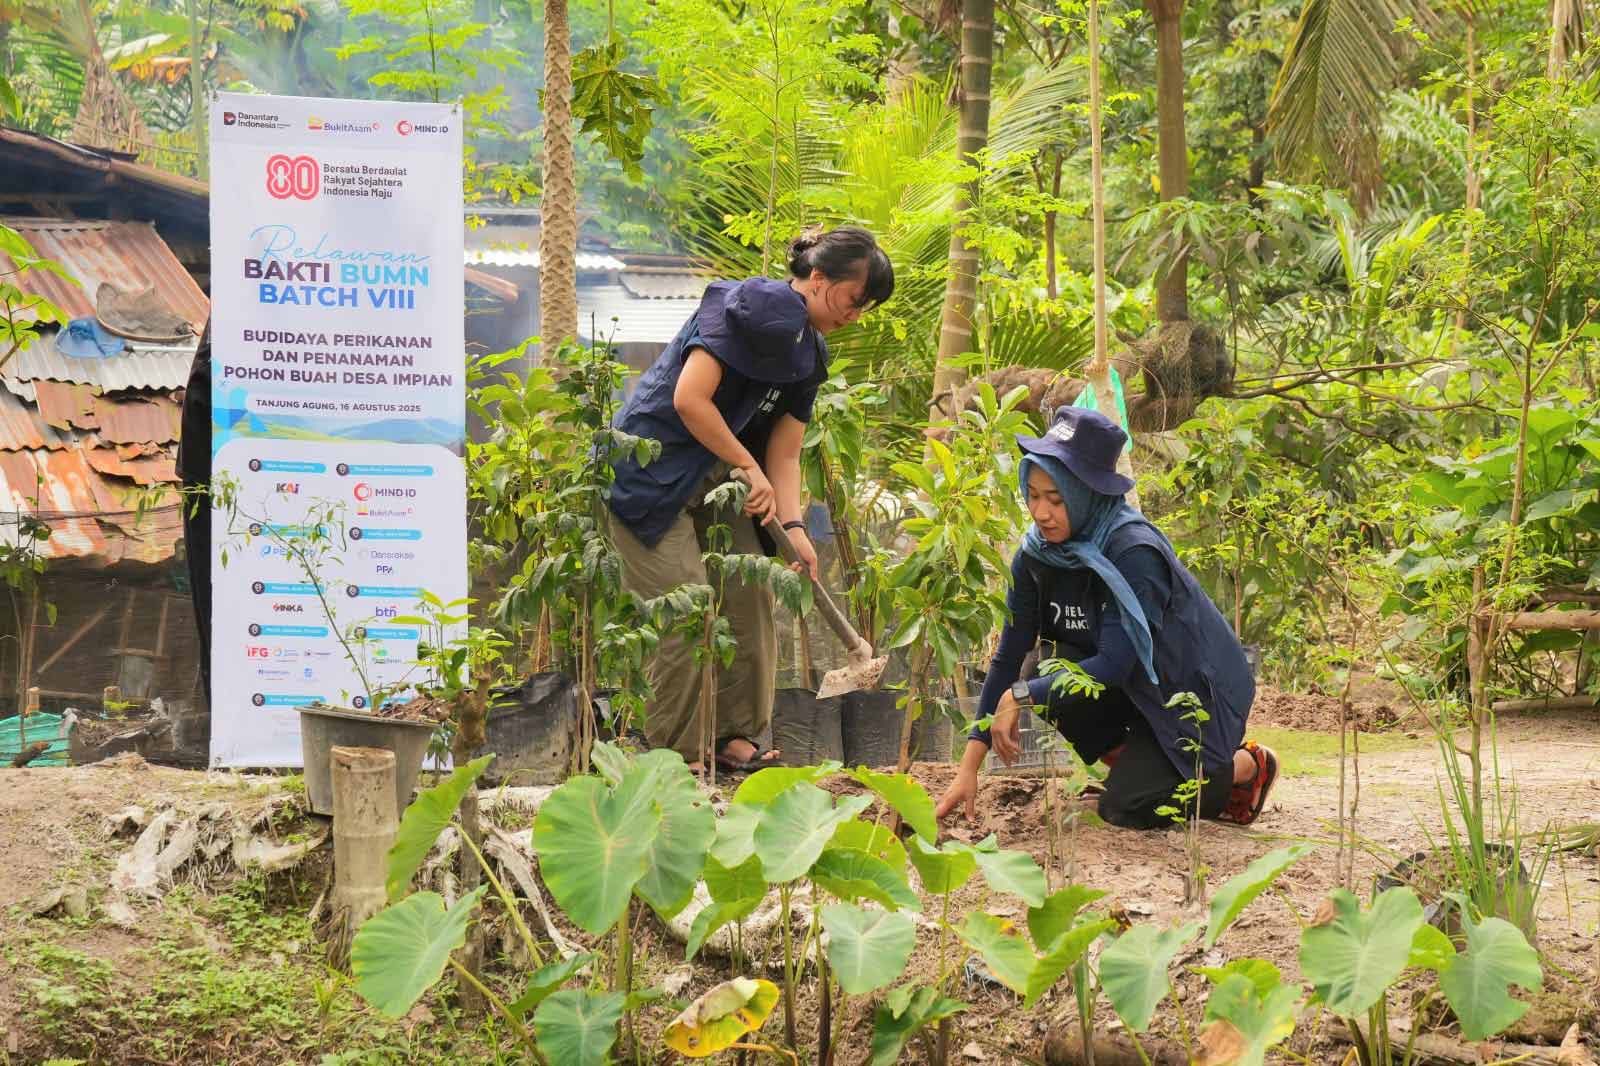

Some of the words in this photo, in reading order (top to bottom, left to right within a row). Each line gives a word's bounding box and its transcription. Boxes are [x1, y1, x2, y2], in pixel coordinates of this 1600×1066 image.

[238, 112, 279, 122] Danantara
[238, 120, 276, 129] Indonesia
[324, 122, 372, 133] BukitAsam
[414, 125, 438, 133] MIND
[324, 164, 360, 174] Bersatu
[362, 166, 407, 176] Berdaulat
[266, 154, 320, 200] 80
[324, 175, 356, 186] Rakyat
[358, 177, 402, 188] Sejahtera
[324, 187, 369, 197] Indonesia
[371, 188, 392, 199] Maju
[250, 224, 431, 264] Relawan
[244, 259, 330, 282] BAKTI
[341, 264, 428, 288] BUMN
[260, 284, 358, 307] BATCH
[368, 289, 415, 309] VIII
[244, 329, 328, 346] BUDIDAYA
[334, 334, 432, 348] PERIKANAN
[263, 350, 298, 363] DAN
[304, 352, 414, 366] PENANAMAN
[224, 366, 286, 381] POHON
[290, 370, 337, 383] BUAH
[343, 372, 388, 385] DESA
[394, 374, 452, 386] IMPIAN
[256, 399, 300, 408] TANJUNG
[302, 402, 338, 411] AGUNG,
[340, 402, 350, 410] 16
[352, 403, 396, 412] AGUSTUS
[398, 404, 421, 412] 2025
[375, 488, 403, 497] MIND
[405, 489, 416, 498] ID
[280, 604, 304, 612] INKA
